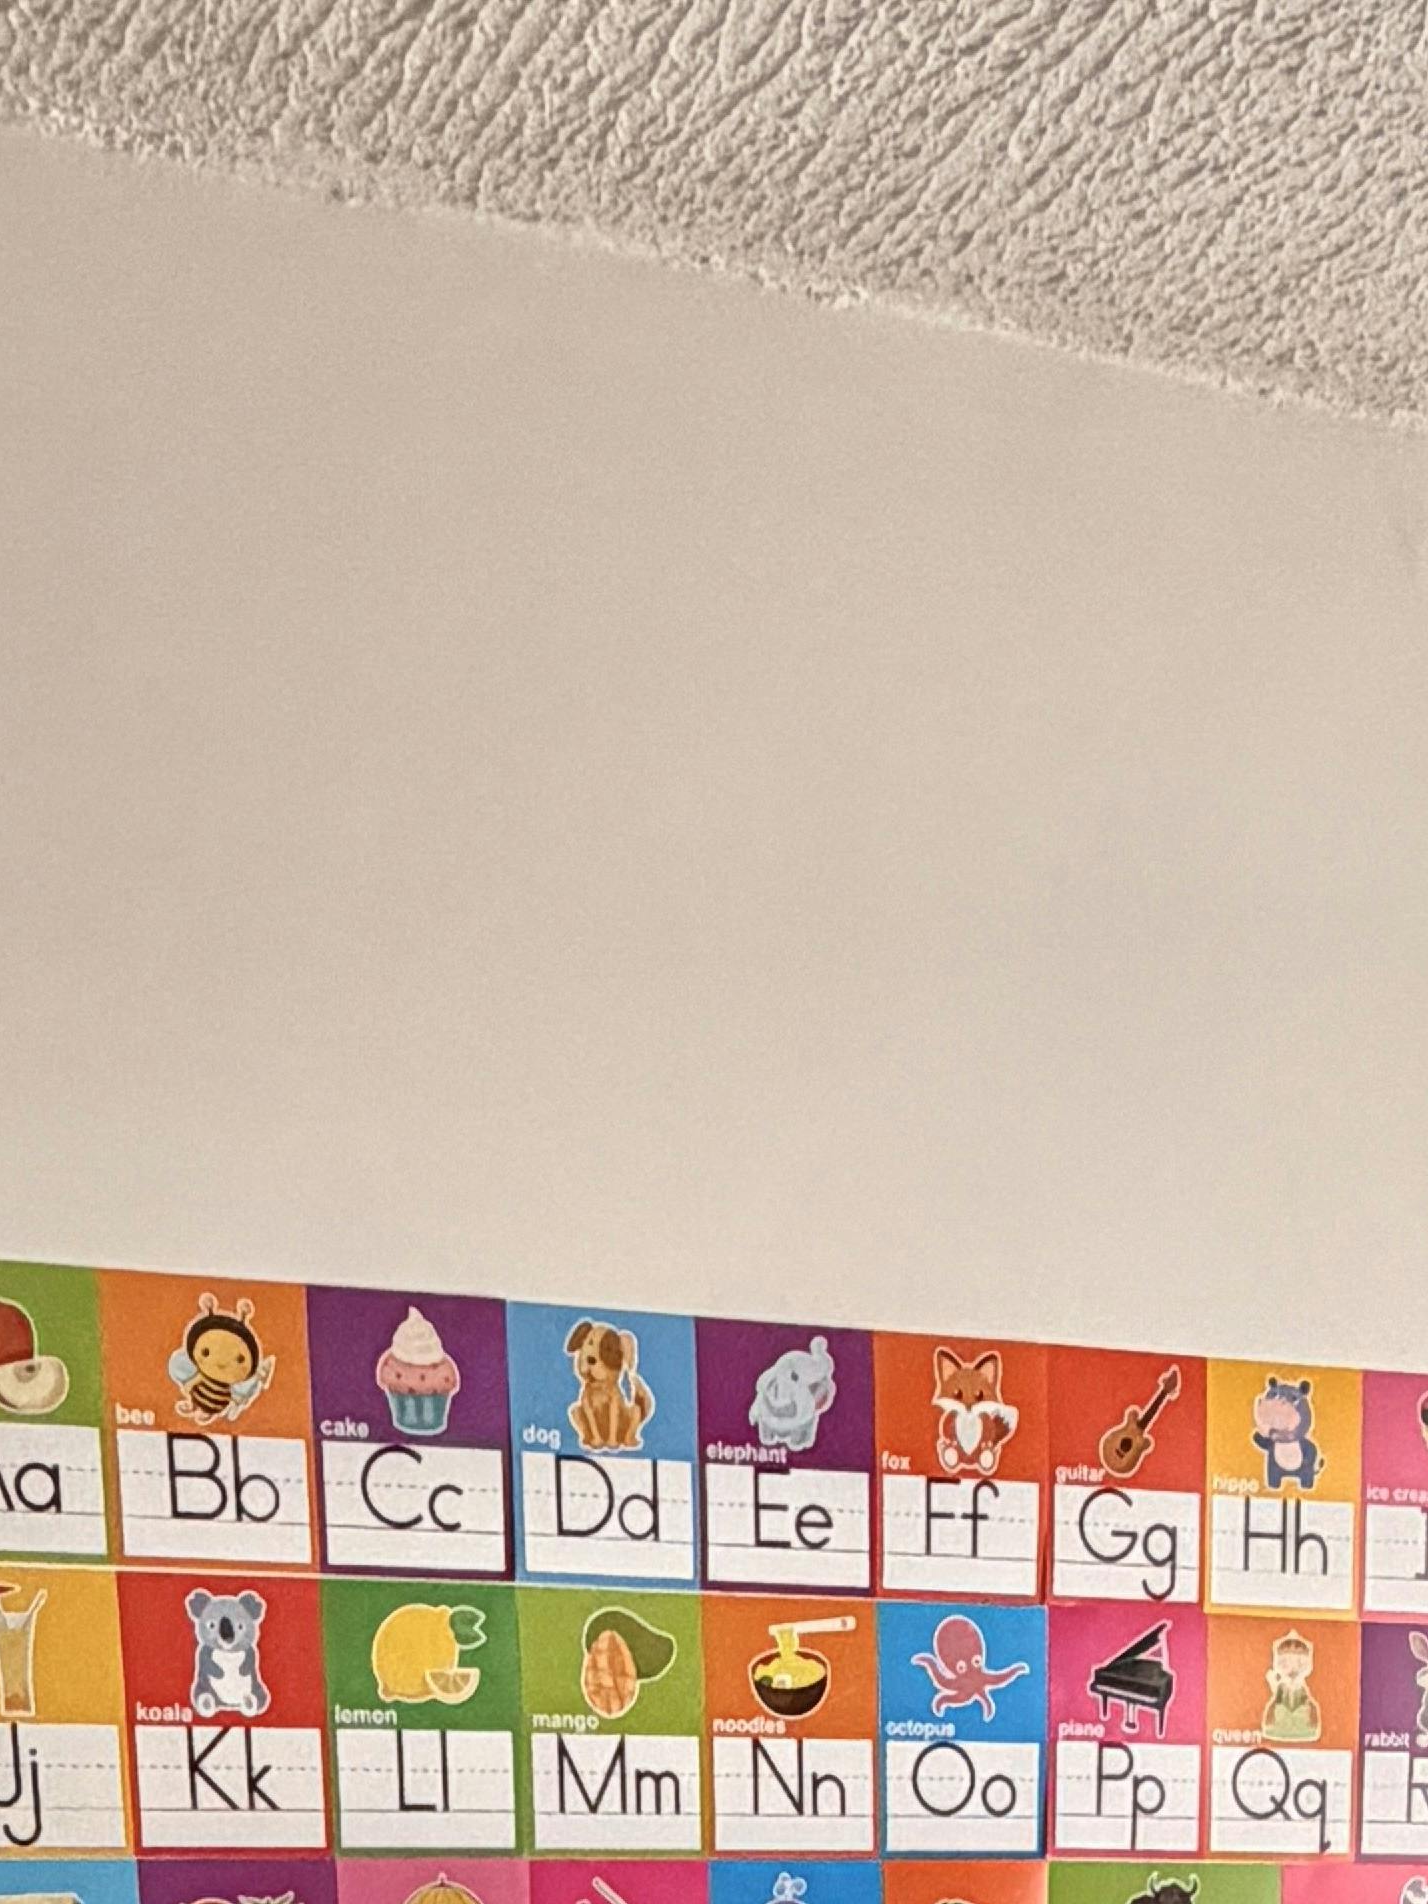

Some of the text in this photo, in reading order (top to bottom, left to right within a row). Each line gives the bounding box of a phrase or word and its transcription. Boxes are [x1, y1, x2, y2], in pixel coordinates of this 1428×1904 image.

[116, 1405, 155, 1427] bee
[321, 1418, 368, 1438] cake
[523, 1426, 561, 1448] dog
[706, 1443, 787, 1465] elephant
[881, 1451, 911, 1470] fox
[168, 1432, 280, 1521] Bb
[1055, 1466, 1106, 1484] guitar
[361, 1445, 463, 1532] Cc
[556, 1456, 659, 1541] Dd
[1366, 1487, 1390, 1500] ice
[754, 1468, 833, 1549] Ee
[925, 1478, 999, 1558] Ff
[1079, 1488, 1177, 1600] Gg
[1243, 1497, 1327, 1575] Hh
[136, 1702, 192, 1722] koala
[335, 1705, 397, 1725] lemon
[532, 1714, 599, 1731] mango
[712, 1718, 785, 1734] noodles
[887, 1722, 955, 1737] octopus
[1058, 1722, 1105, 1741] piano
[1213, 1728, 1261, 1745] queen
[1365, 1731, 1409, 1748] rabbit
[188, 1728, 281, 1810] Kk
[398, 1730, 449, 1812] Ll
[558, 1736, 681, 1815] Mm
[753, 1738, 845, 1816] Nn
[913, 1742, 1016, 1816] Oo
[1096, 1742, 1165, 1850] Pp
[1232, 1748, 1331, 1853] Qq
